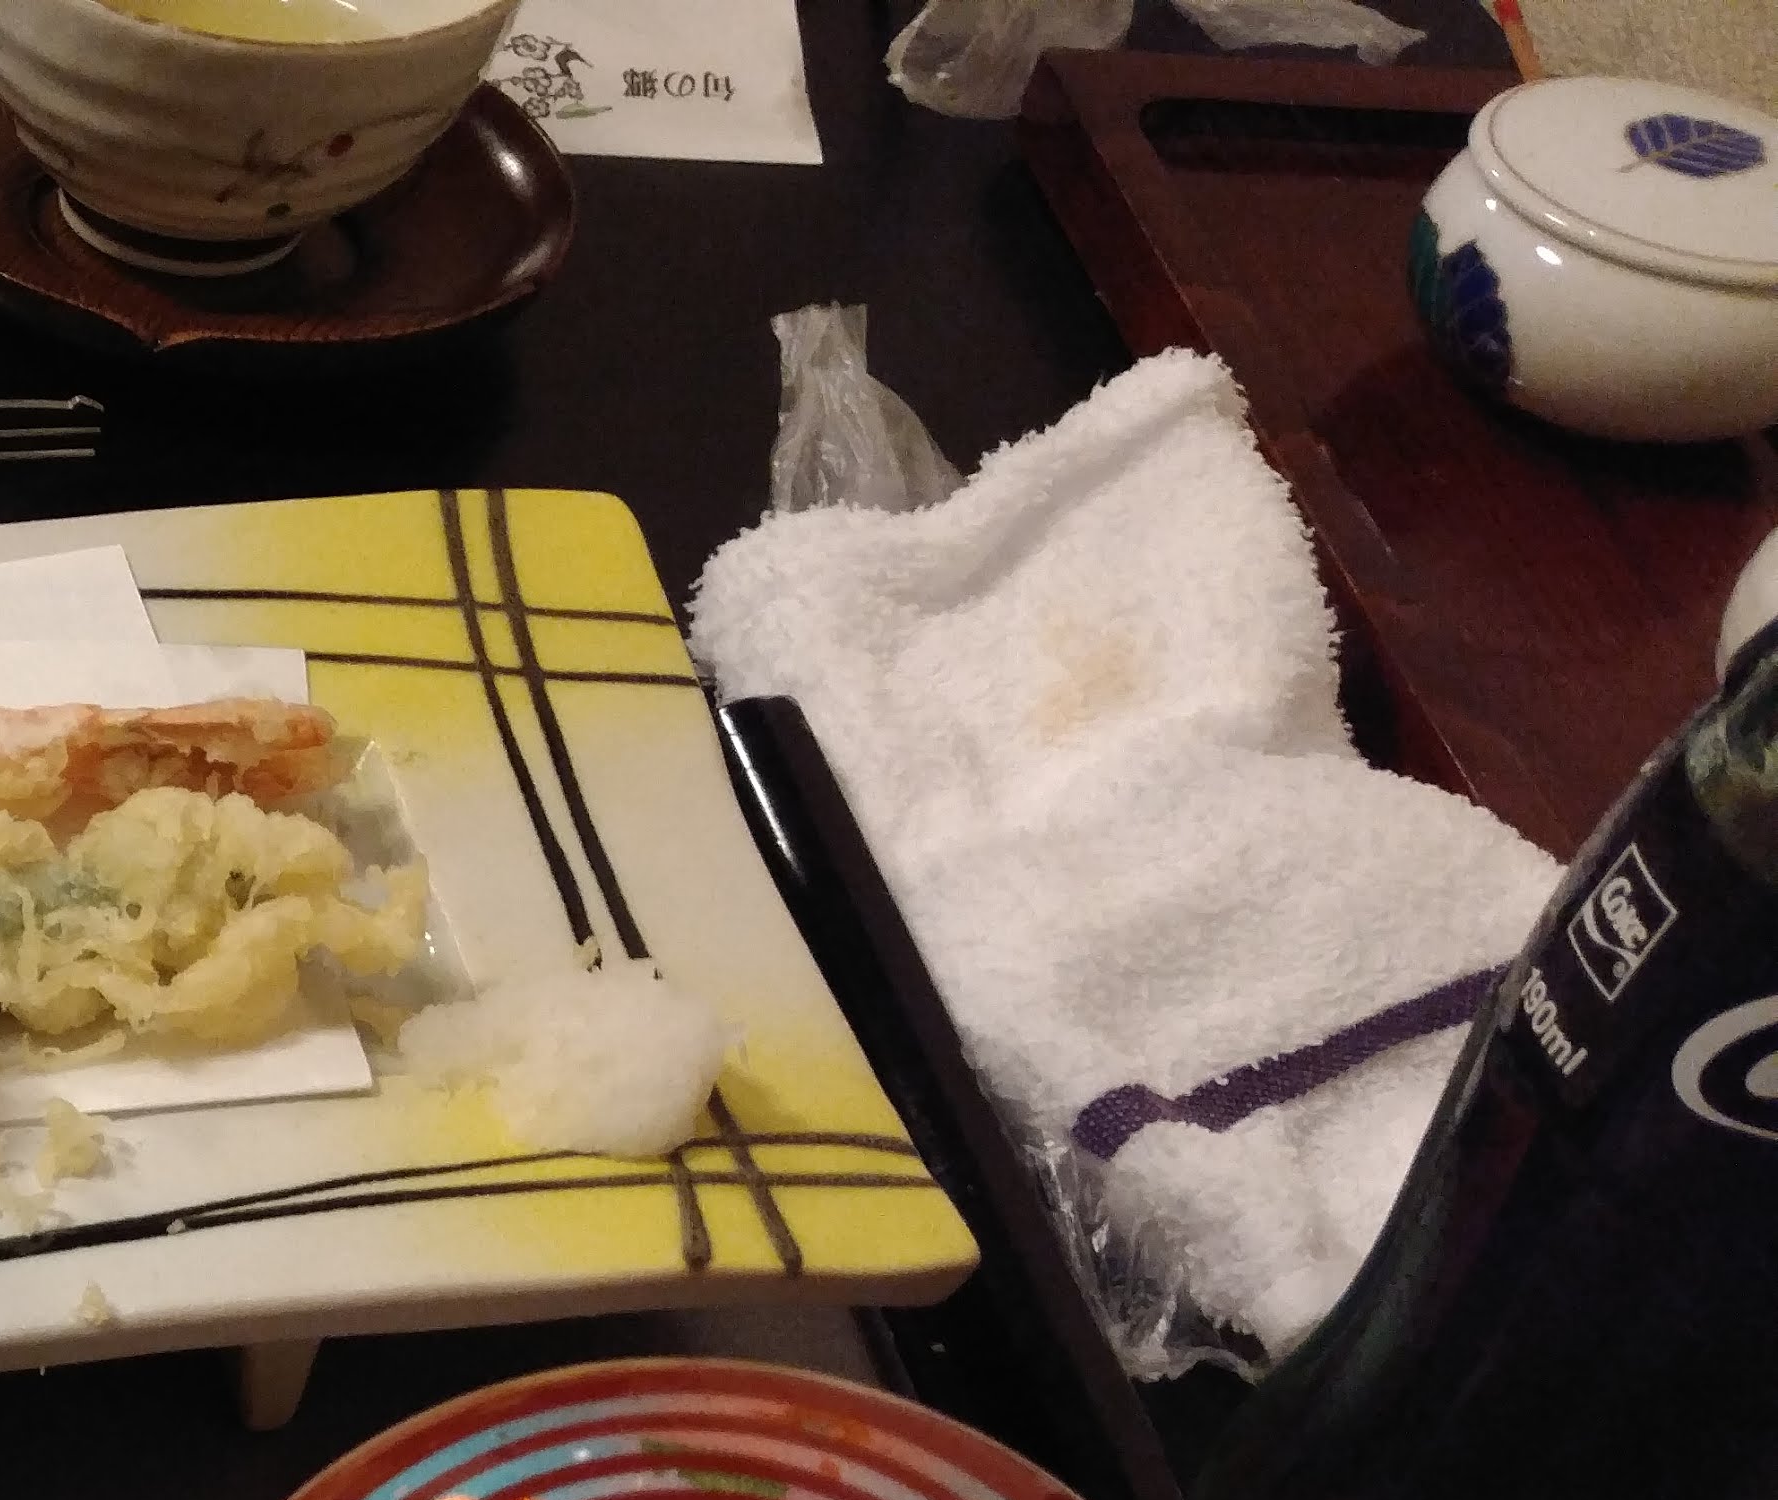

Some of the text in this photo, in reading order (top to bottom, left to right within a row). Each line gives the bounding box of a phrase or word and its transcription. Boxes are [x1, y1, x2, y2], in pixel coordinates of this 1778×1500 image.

[621, 67, 736, 102] 旬の郷
[1599, 875, 1650, 951] Coke
[1520, 966, 1590, 1077] 190ml
